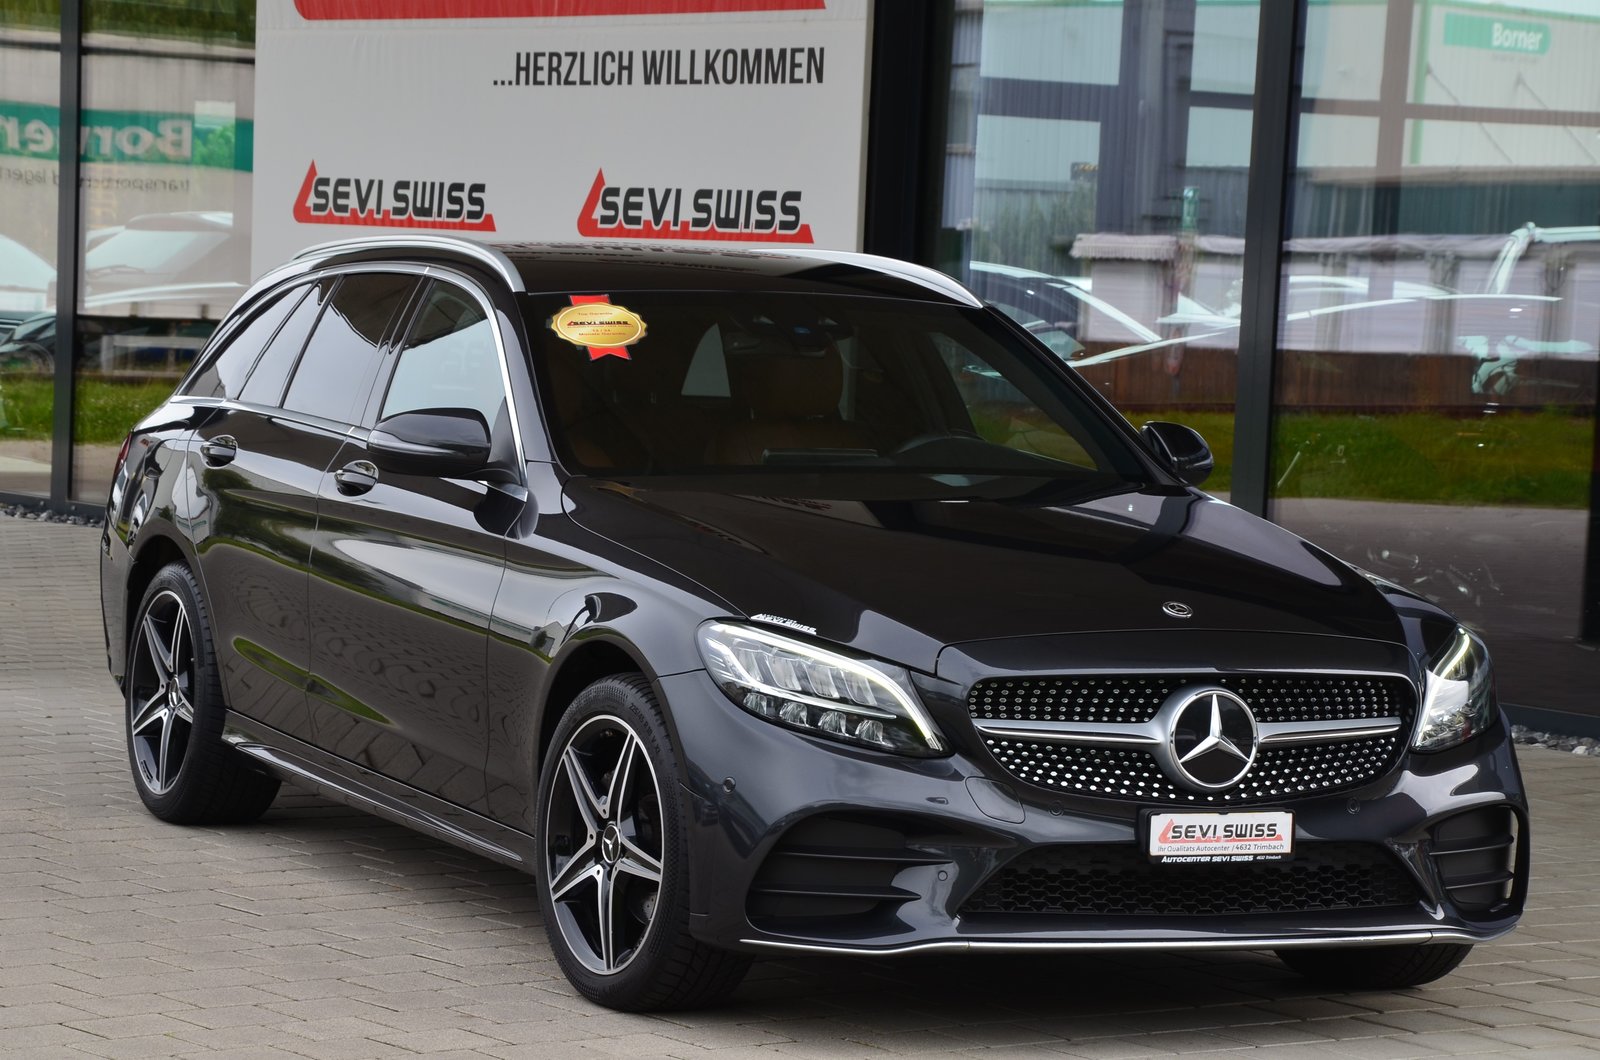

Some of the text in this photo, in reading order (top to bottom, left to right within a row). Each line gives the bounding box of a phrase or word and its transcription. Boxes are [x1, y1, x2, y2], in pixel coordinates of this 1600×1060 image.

[1491, 22, 1543, 50] Borner
[493, 47, 825, 86] ...HERZLICH WILLKOMMEN
[313, 177, 486, 220] SEVI SWISS
[599, 187, 802, 231] SEVI SWISS
[1171, 823, 1277, 839] SEVI SWISS
[1253, 843, 1284, 851] Trimbach
